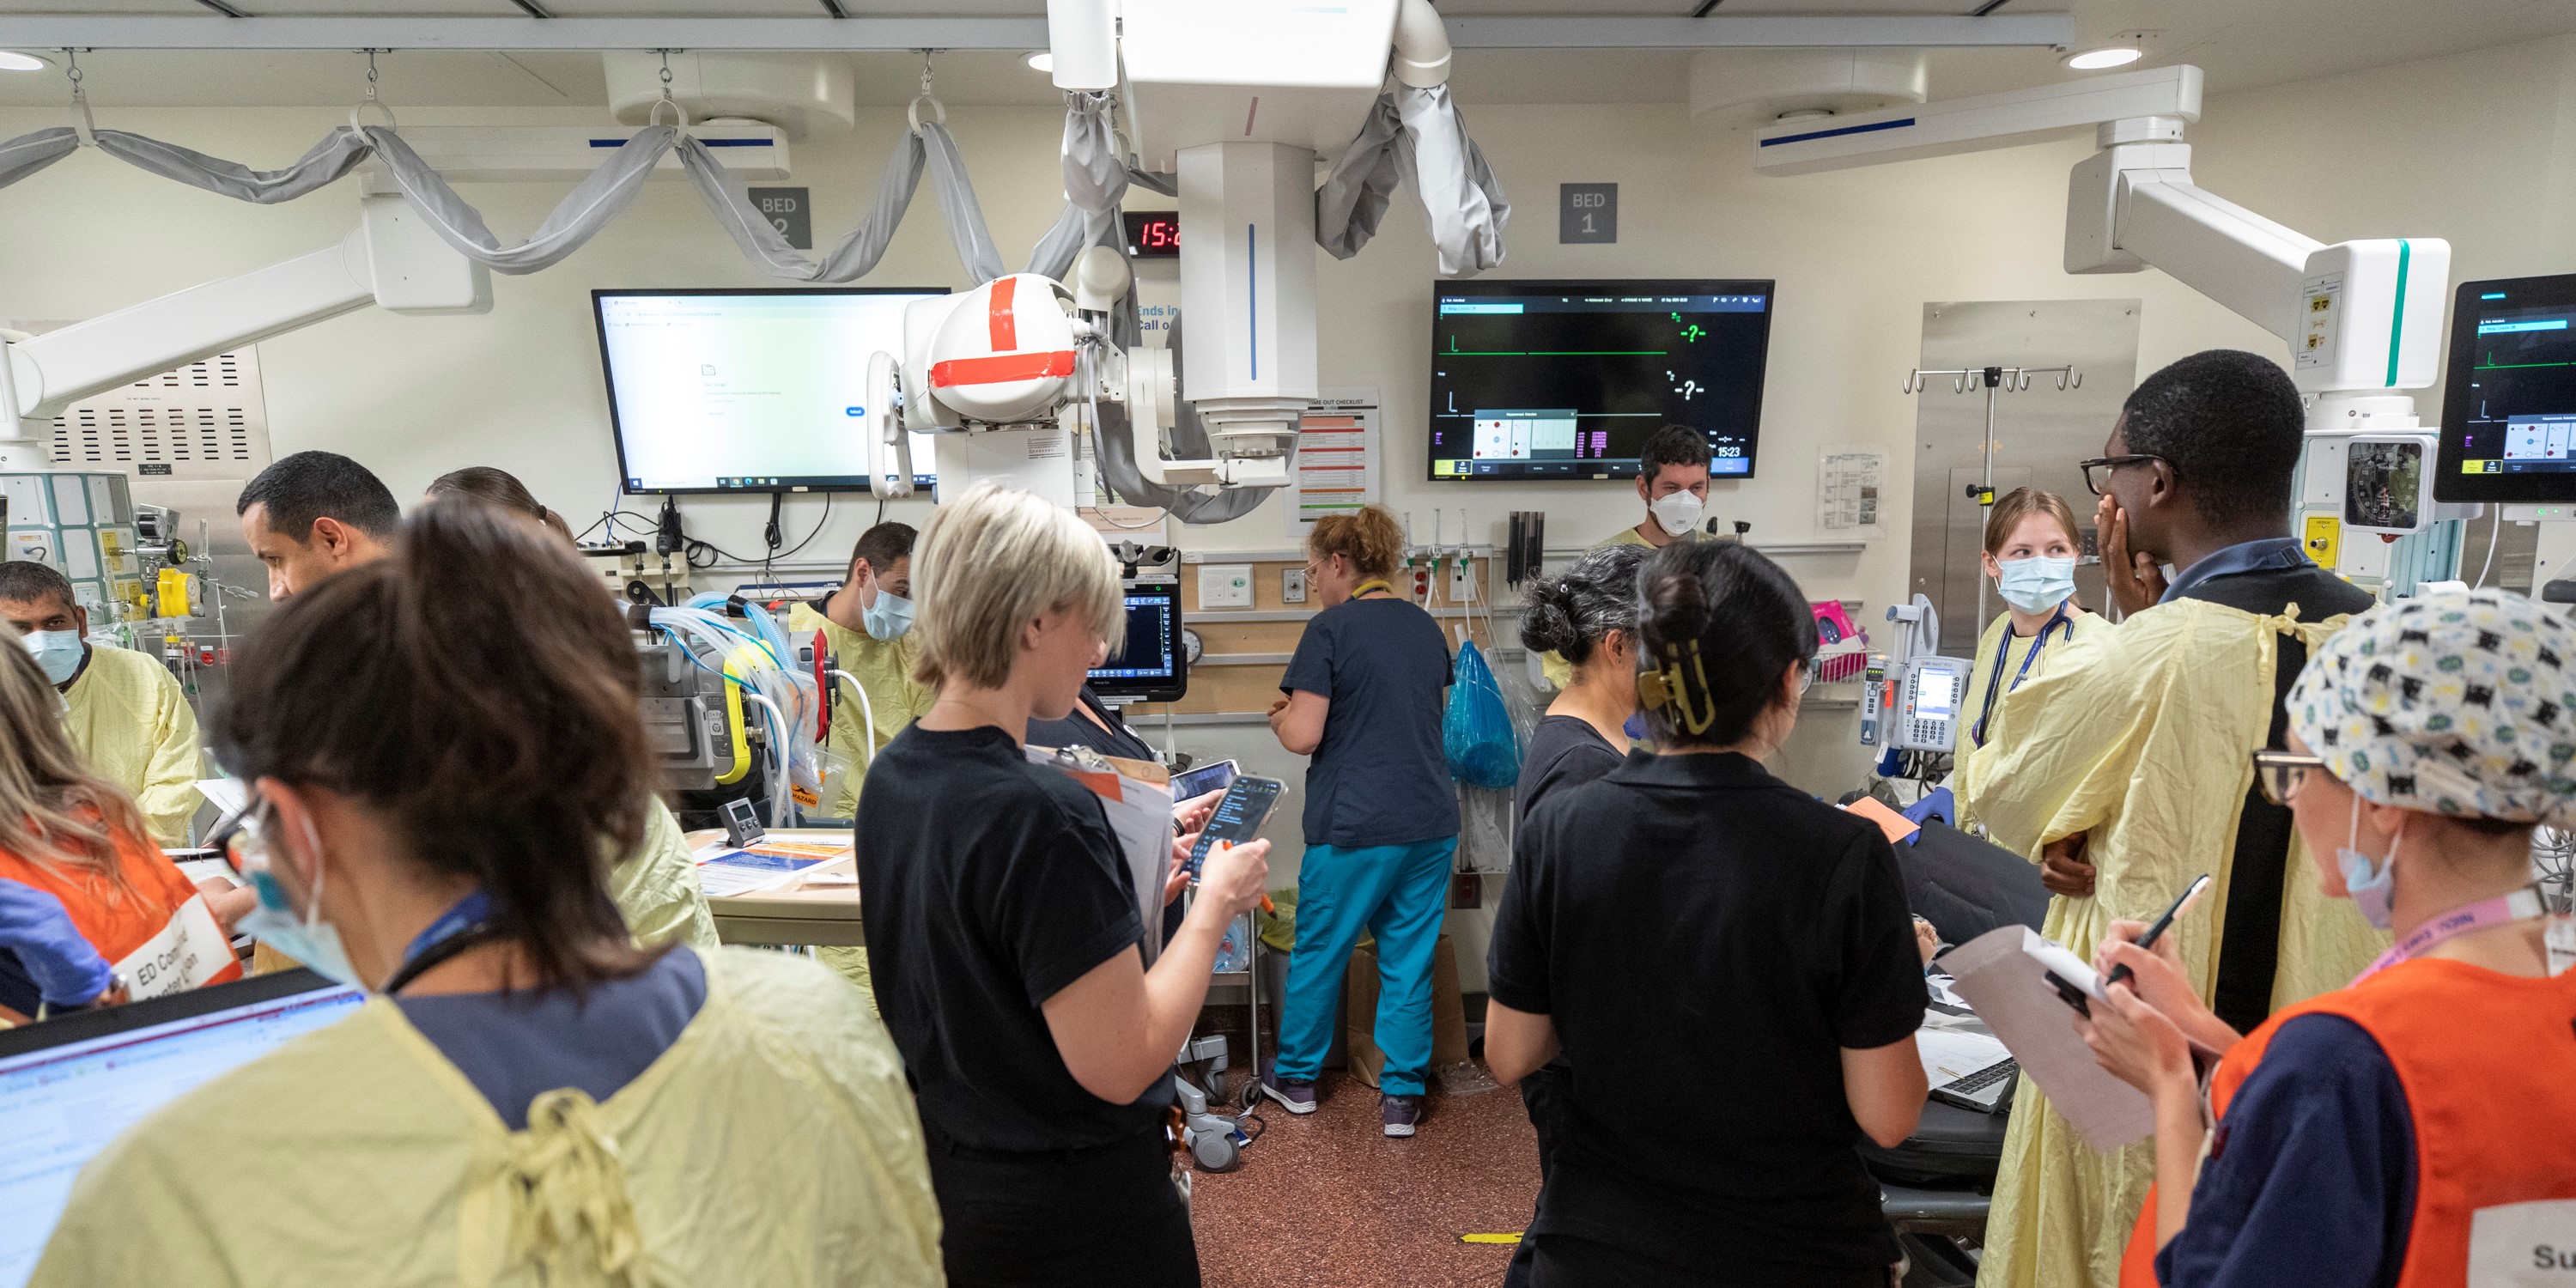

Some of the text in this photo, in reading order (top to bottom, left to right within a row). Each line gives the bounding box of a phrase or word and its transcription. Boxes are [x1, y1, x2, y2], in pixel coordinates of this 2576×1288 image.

[762, 197, 796, 213] BED
[1573, 193, 1605, 207] BED
[773, 217, 789, 239] 2
[1582, 212, 1596, 233] 1
[1717, 447, 1741, 458] 15:23
[137, 962, 157, 987] ED
